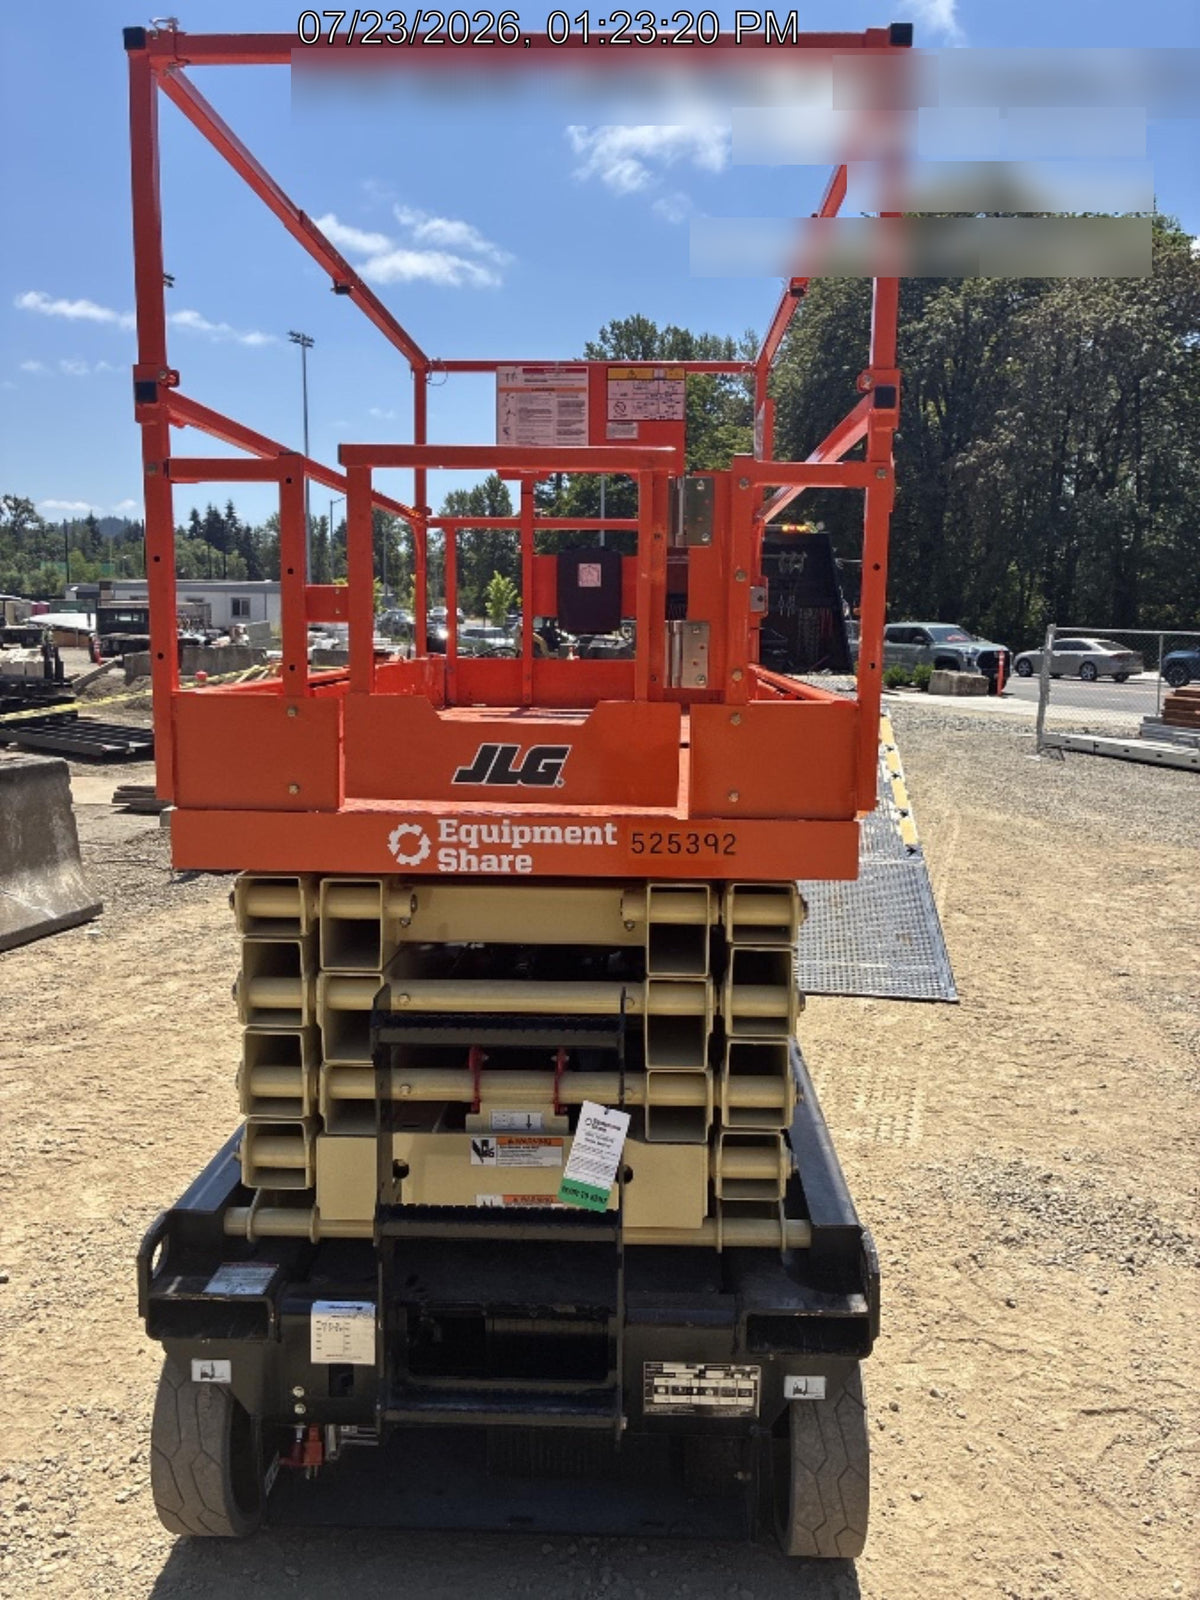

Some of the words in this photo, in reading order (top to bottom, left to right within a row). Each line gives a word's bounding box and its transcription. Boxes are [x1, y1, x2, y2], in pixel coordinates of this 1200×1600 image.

[451, 743, 573, 788] JLG
[437, 819, 617, 848] Equipment
[630, 832, 737, 855] 525392
[437, 848, 533, 873] Share
